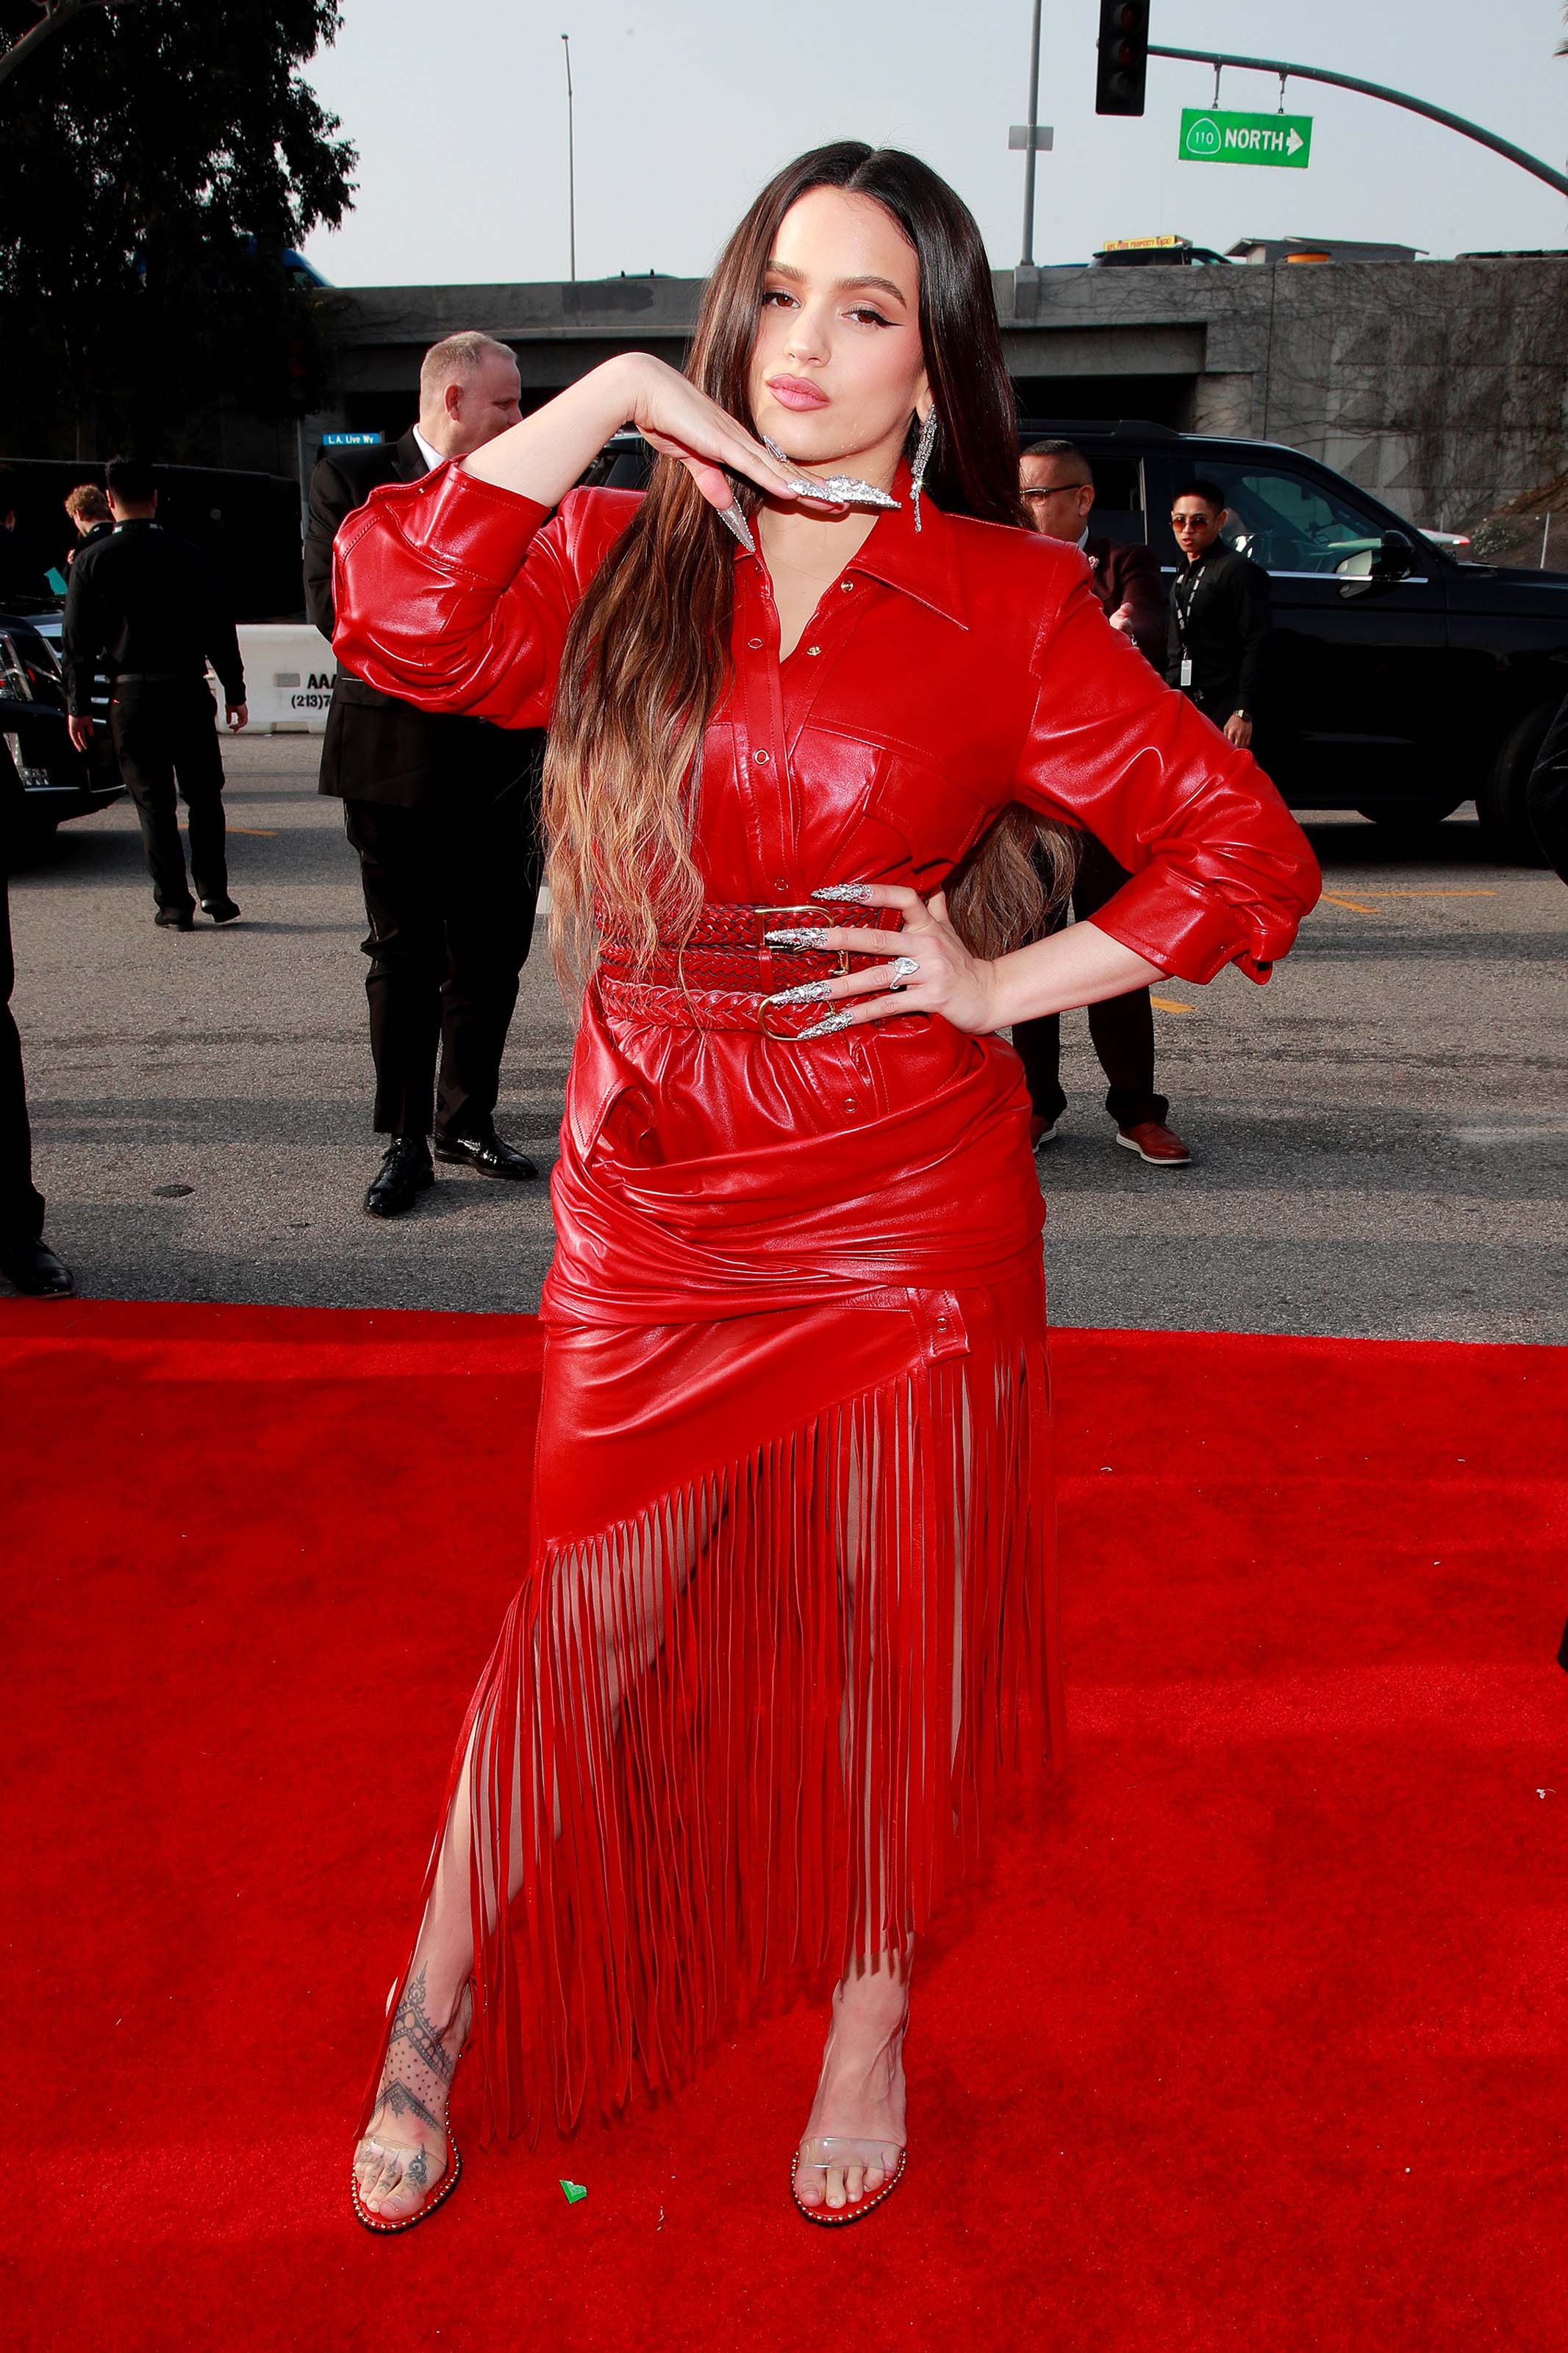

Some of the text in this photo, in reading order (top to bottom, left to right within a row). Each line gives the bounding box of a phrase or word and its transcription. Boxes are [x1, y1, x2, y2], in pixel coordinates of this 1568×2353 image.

[1196, 128, 1284, 151] 110 NORTH
[346, 435, 360, 444] Live
